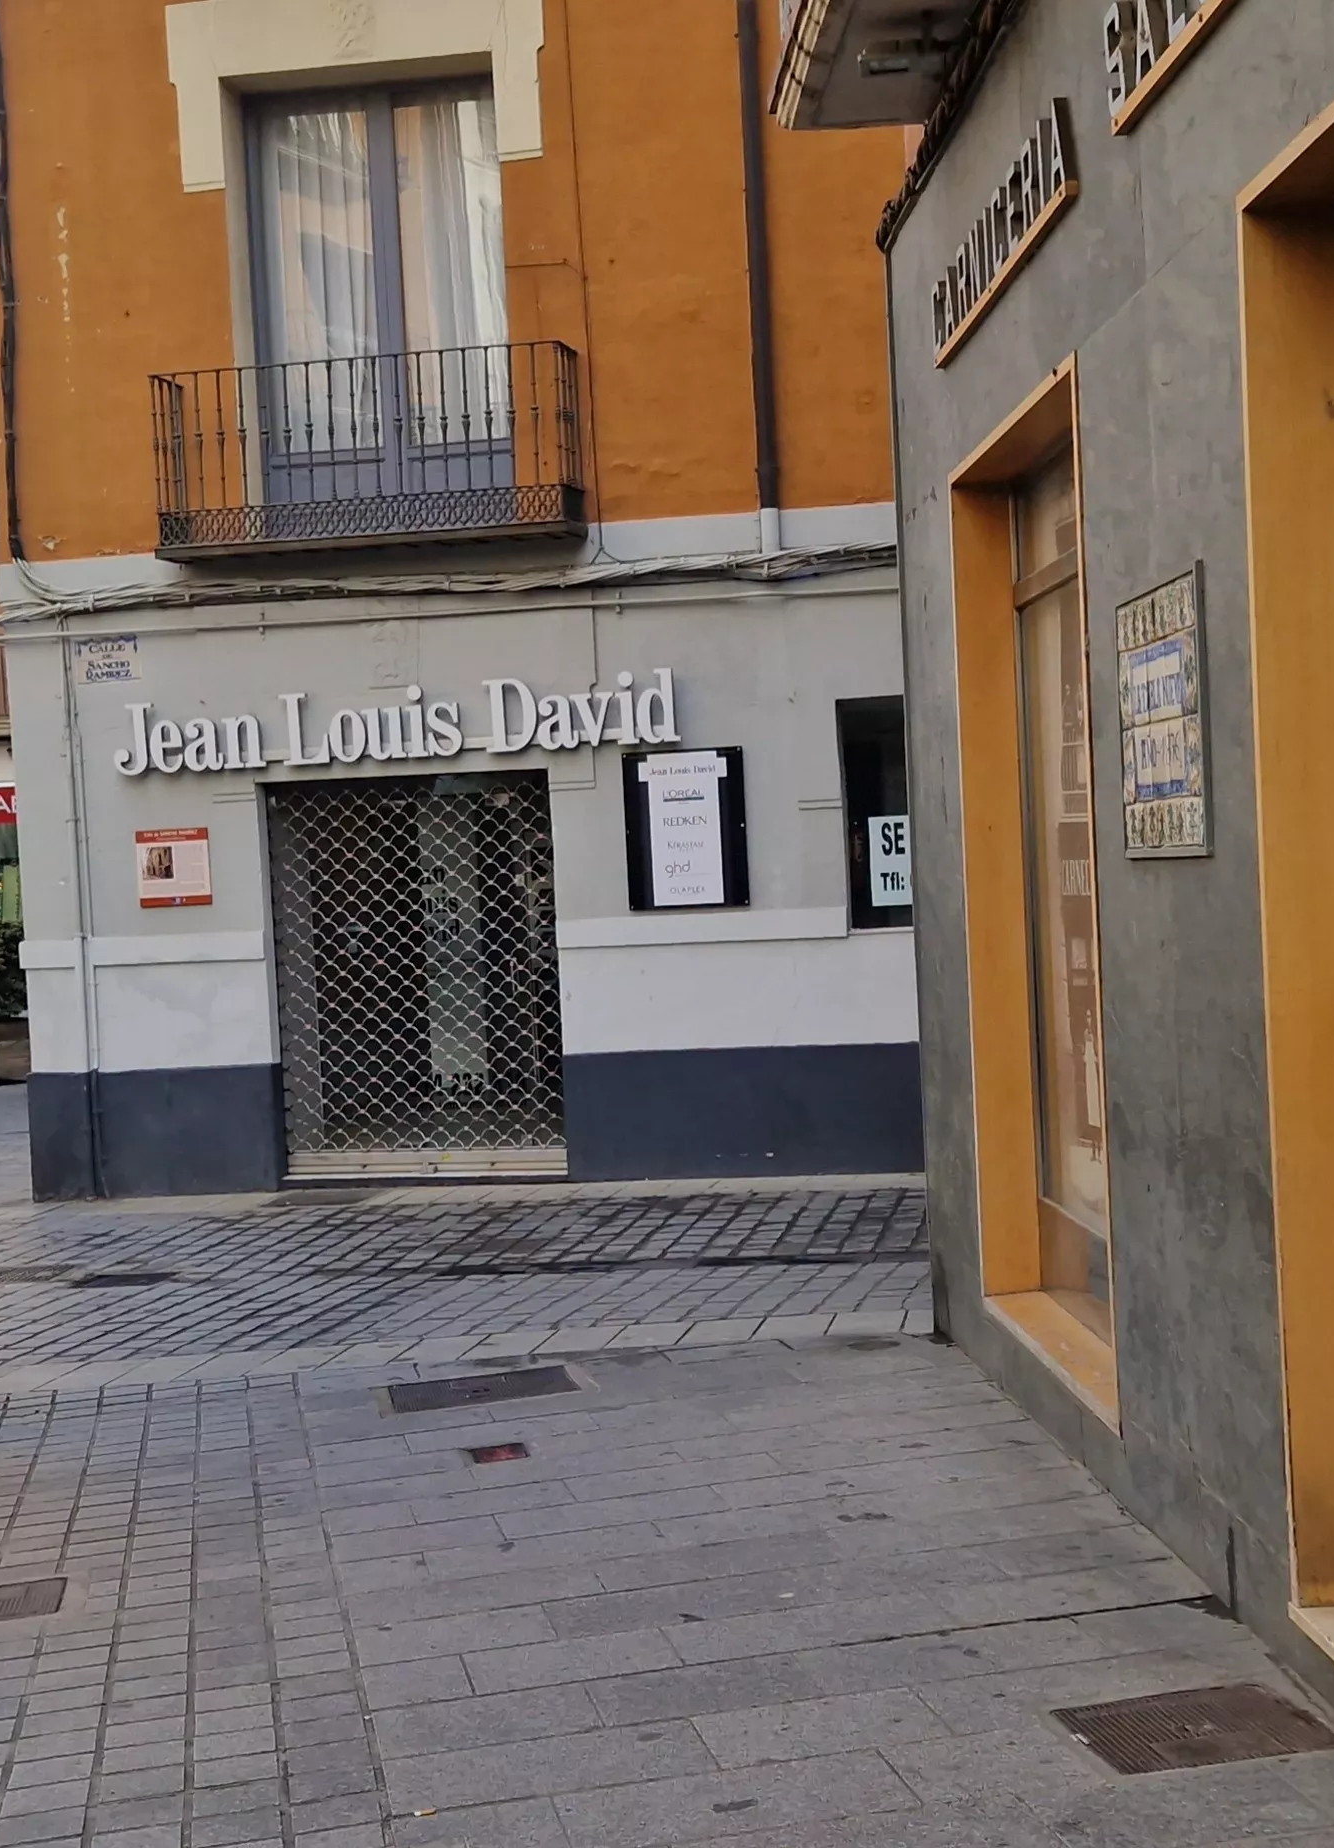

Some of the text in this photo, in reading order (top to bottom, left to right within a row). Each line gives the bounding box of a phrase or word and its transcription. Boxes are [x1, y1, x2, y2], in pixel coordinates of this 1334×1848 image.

[930, 97, 1069, 361] CARNICERIA
[88, 643, 126, 654] CALLE
[87, 660, 131, 670] SANCHO
[113, 667, 682, 777] Jean Louis David
[648, 764, 716, 776] Jean Louis David
[663, 815, 708, 827] REDKEN
[881, 822, 906, 857] SE
[665, 860, 691, 878] ghd
[669, 886, 706, 895] OLAPLEX
